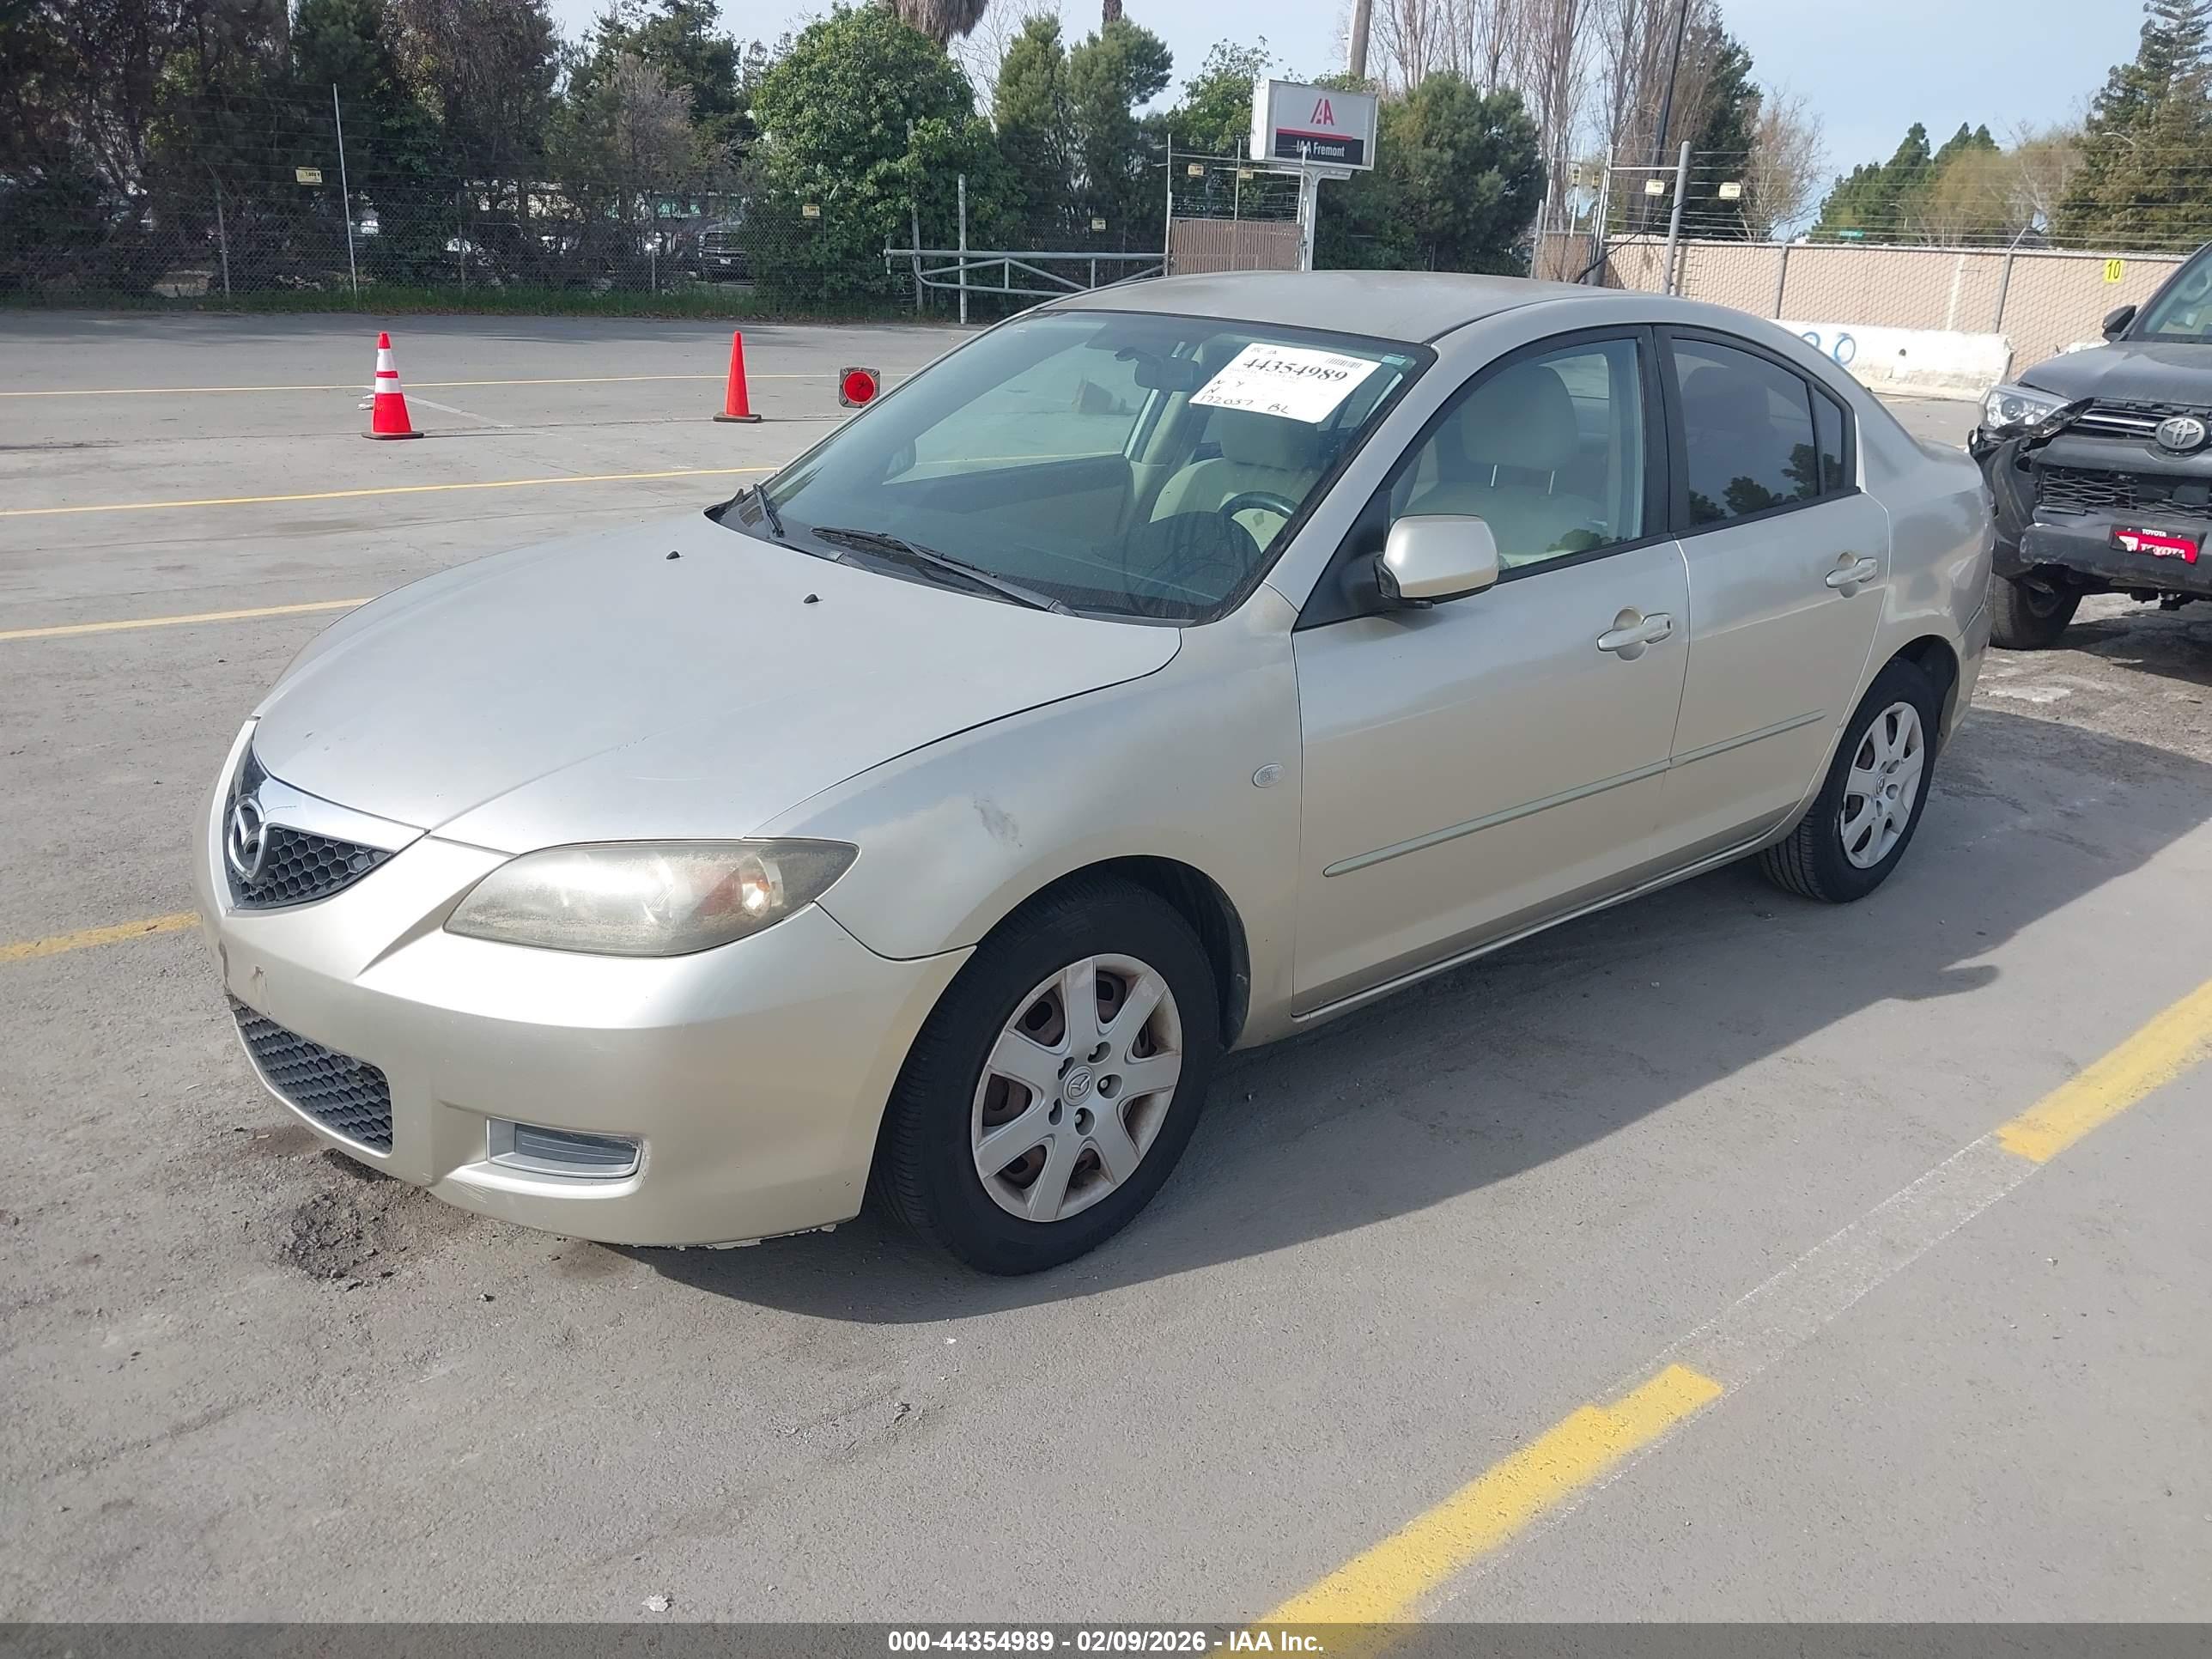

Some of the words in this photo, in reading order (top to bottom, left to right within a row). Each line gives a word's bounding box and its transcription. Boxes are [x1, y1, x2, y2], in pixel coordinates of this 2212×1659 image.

[1297, 140, 1311, 154] IAA
[1313, 142, 1345, 157] Fremont
[2107, 260, 2121, 279] 10
[1243, 358, 1348, 382] 44354989
[2142, 528, 2167, 538] TOYOTA
